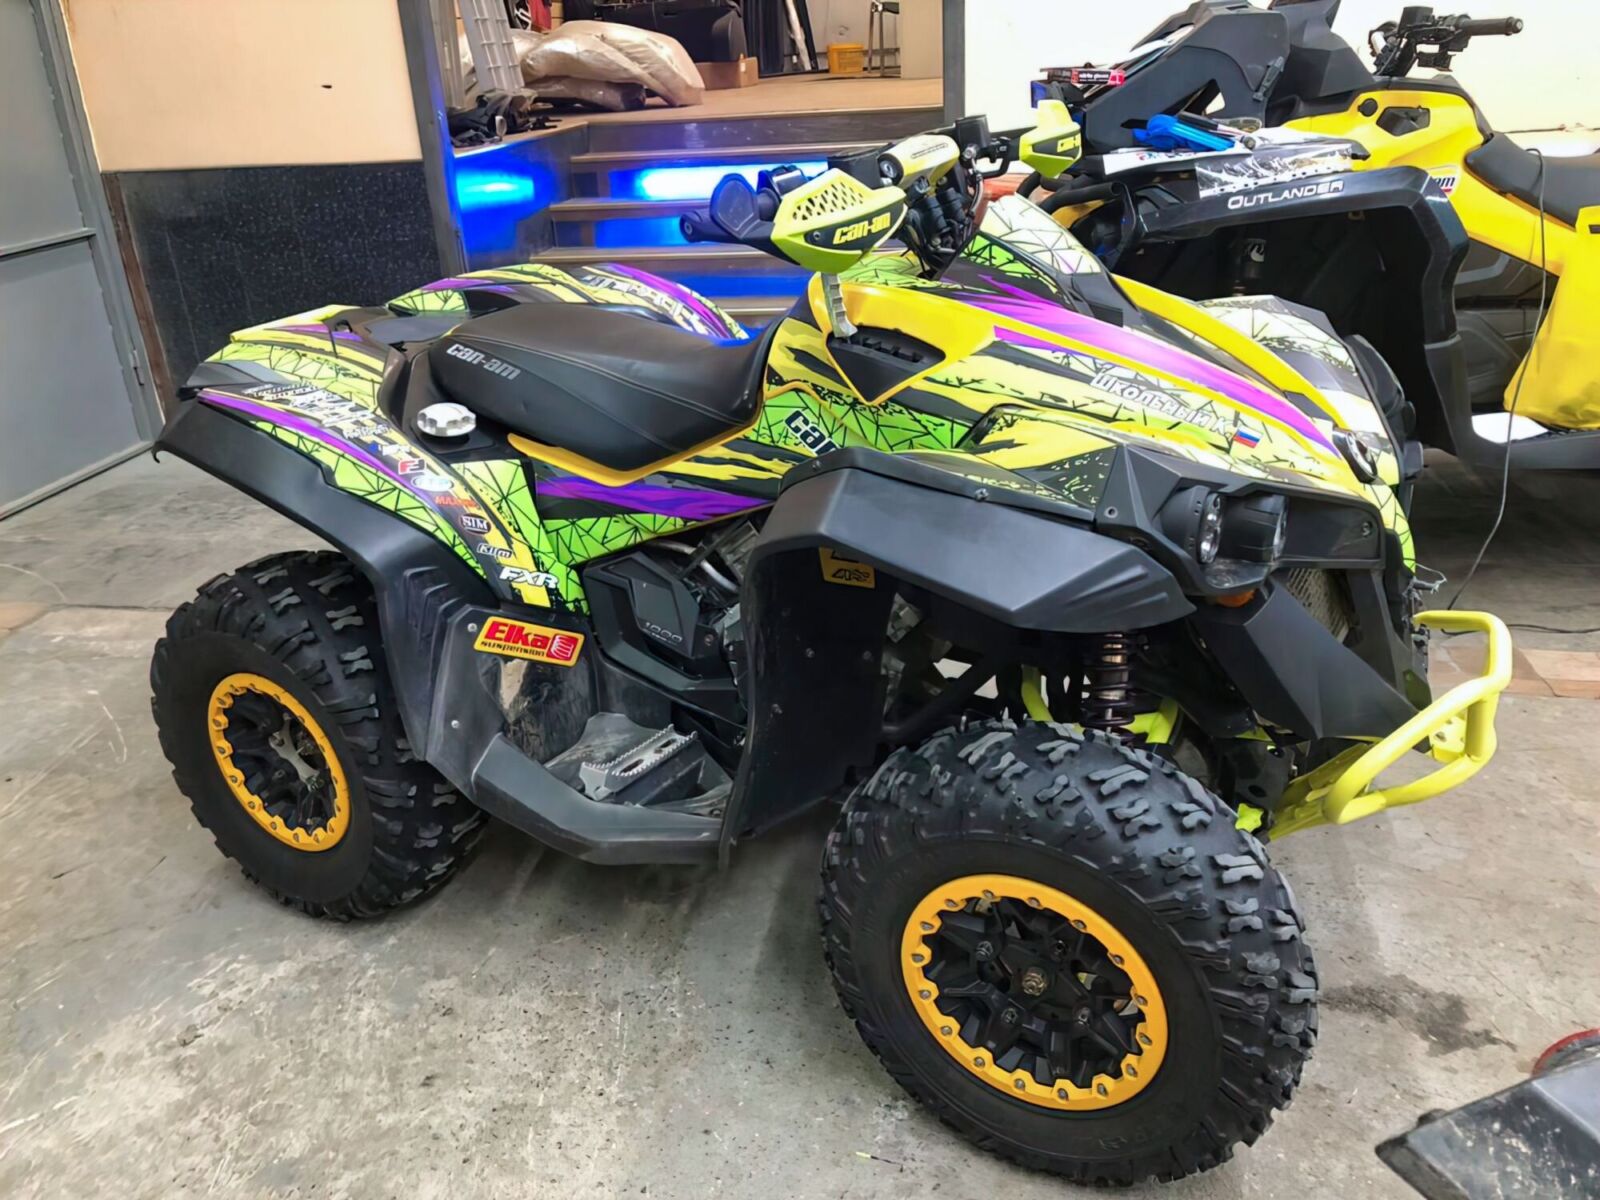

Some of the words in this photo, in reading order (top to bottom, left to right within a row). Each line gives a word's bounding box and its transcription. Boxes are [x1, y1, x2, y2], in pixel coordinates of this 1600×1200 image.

[446, 343, 521, 380] can-am
[499, 565, 559, 589] FXR
[484, 620, 550, 649] Elka
